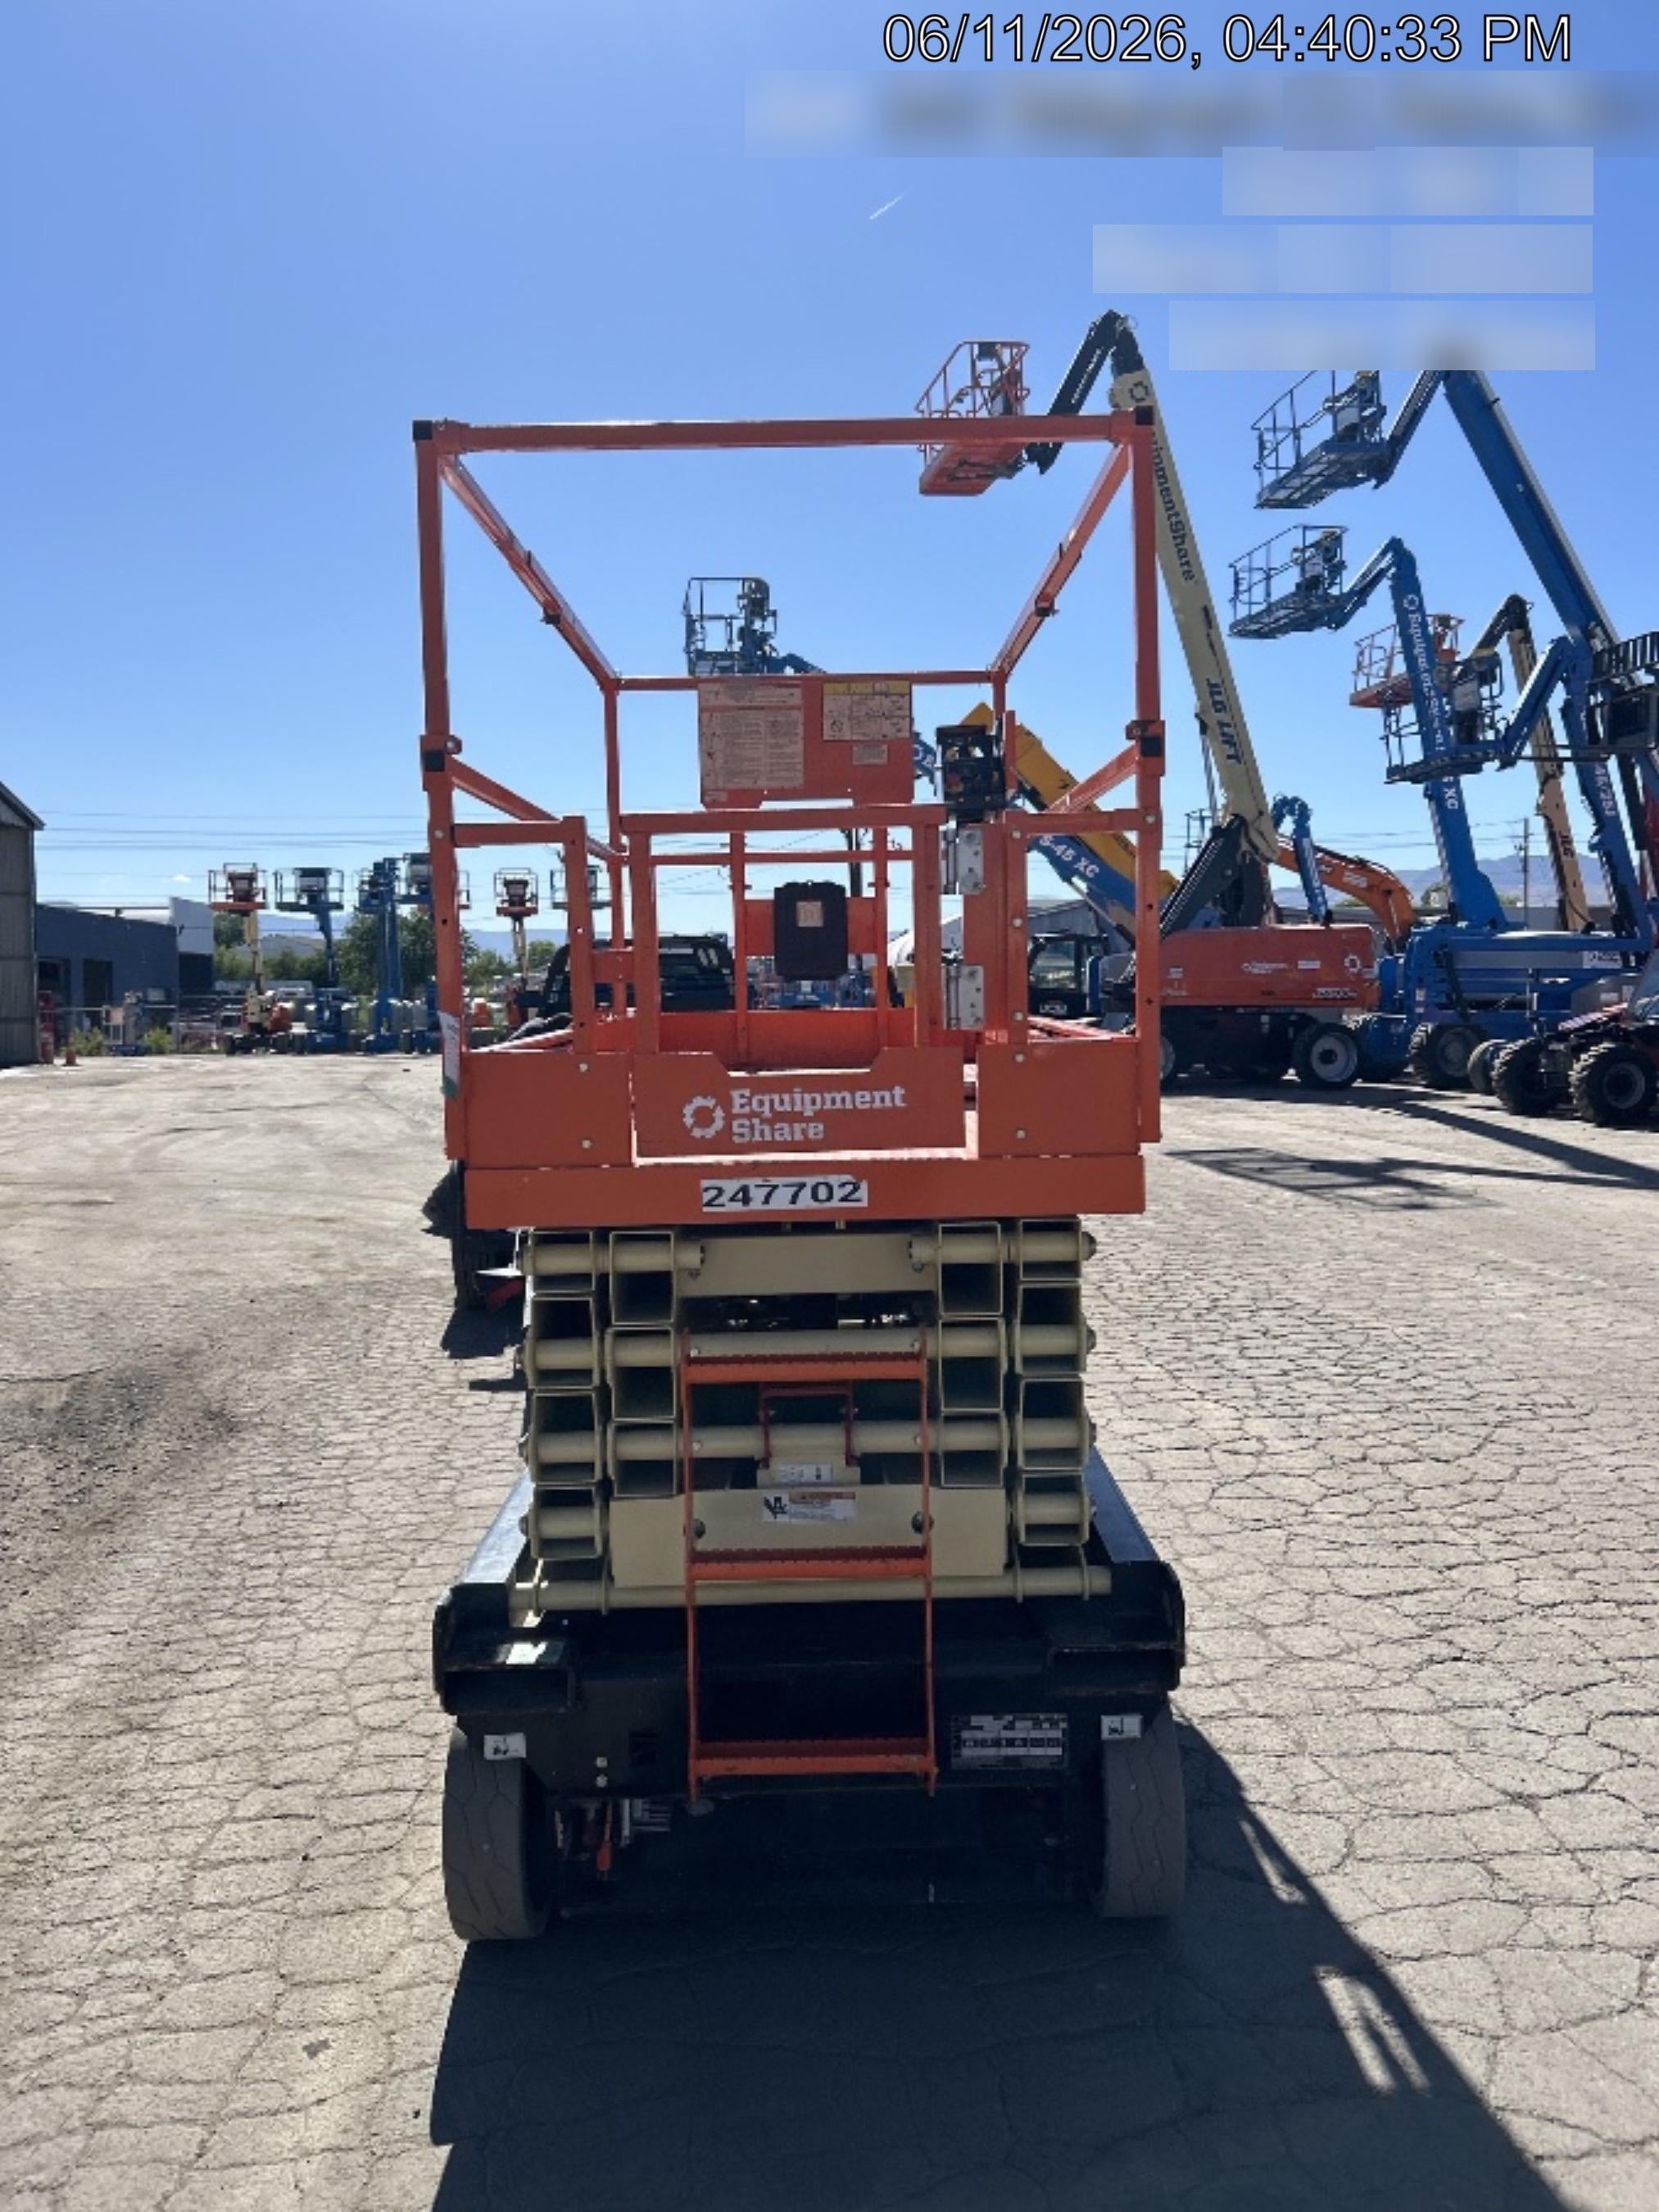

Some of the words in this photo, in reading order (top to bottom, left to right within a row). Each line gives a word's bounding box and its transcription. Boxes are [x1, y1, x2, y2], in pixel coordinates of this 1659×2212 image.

[1206, 678, 1227, 713] JLG
[1217, 720, 1242, 764] LIFT
[1073, 857, 1099, 878] XC
[730, 1085, 907, 1117] Equipment
[732, 1117, 825, 1144] Share
[702, 1181, 863, 1208] 247702
